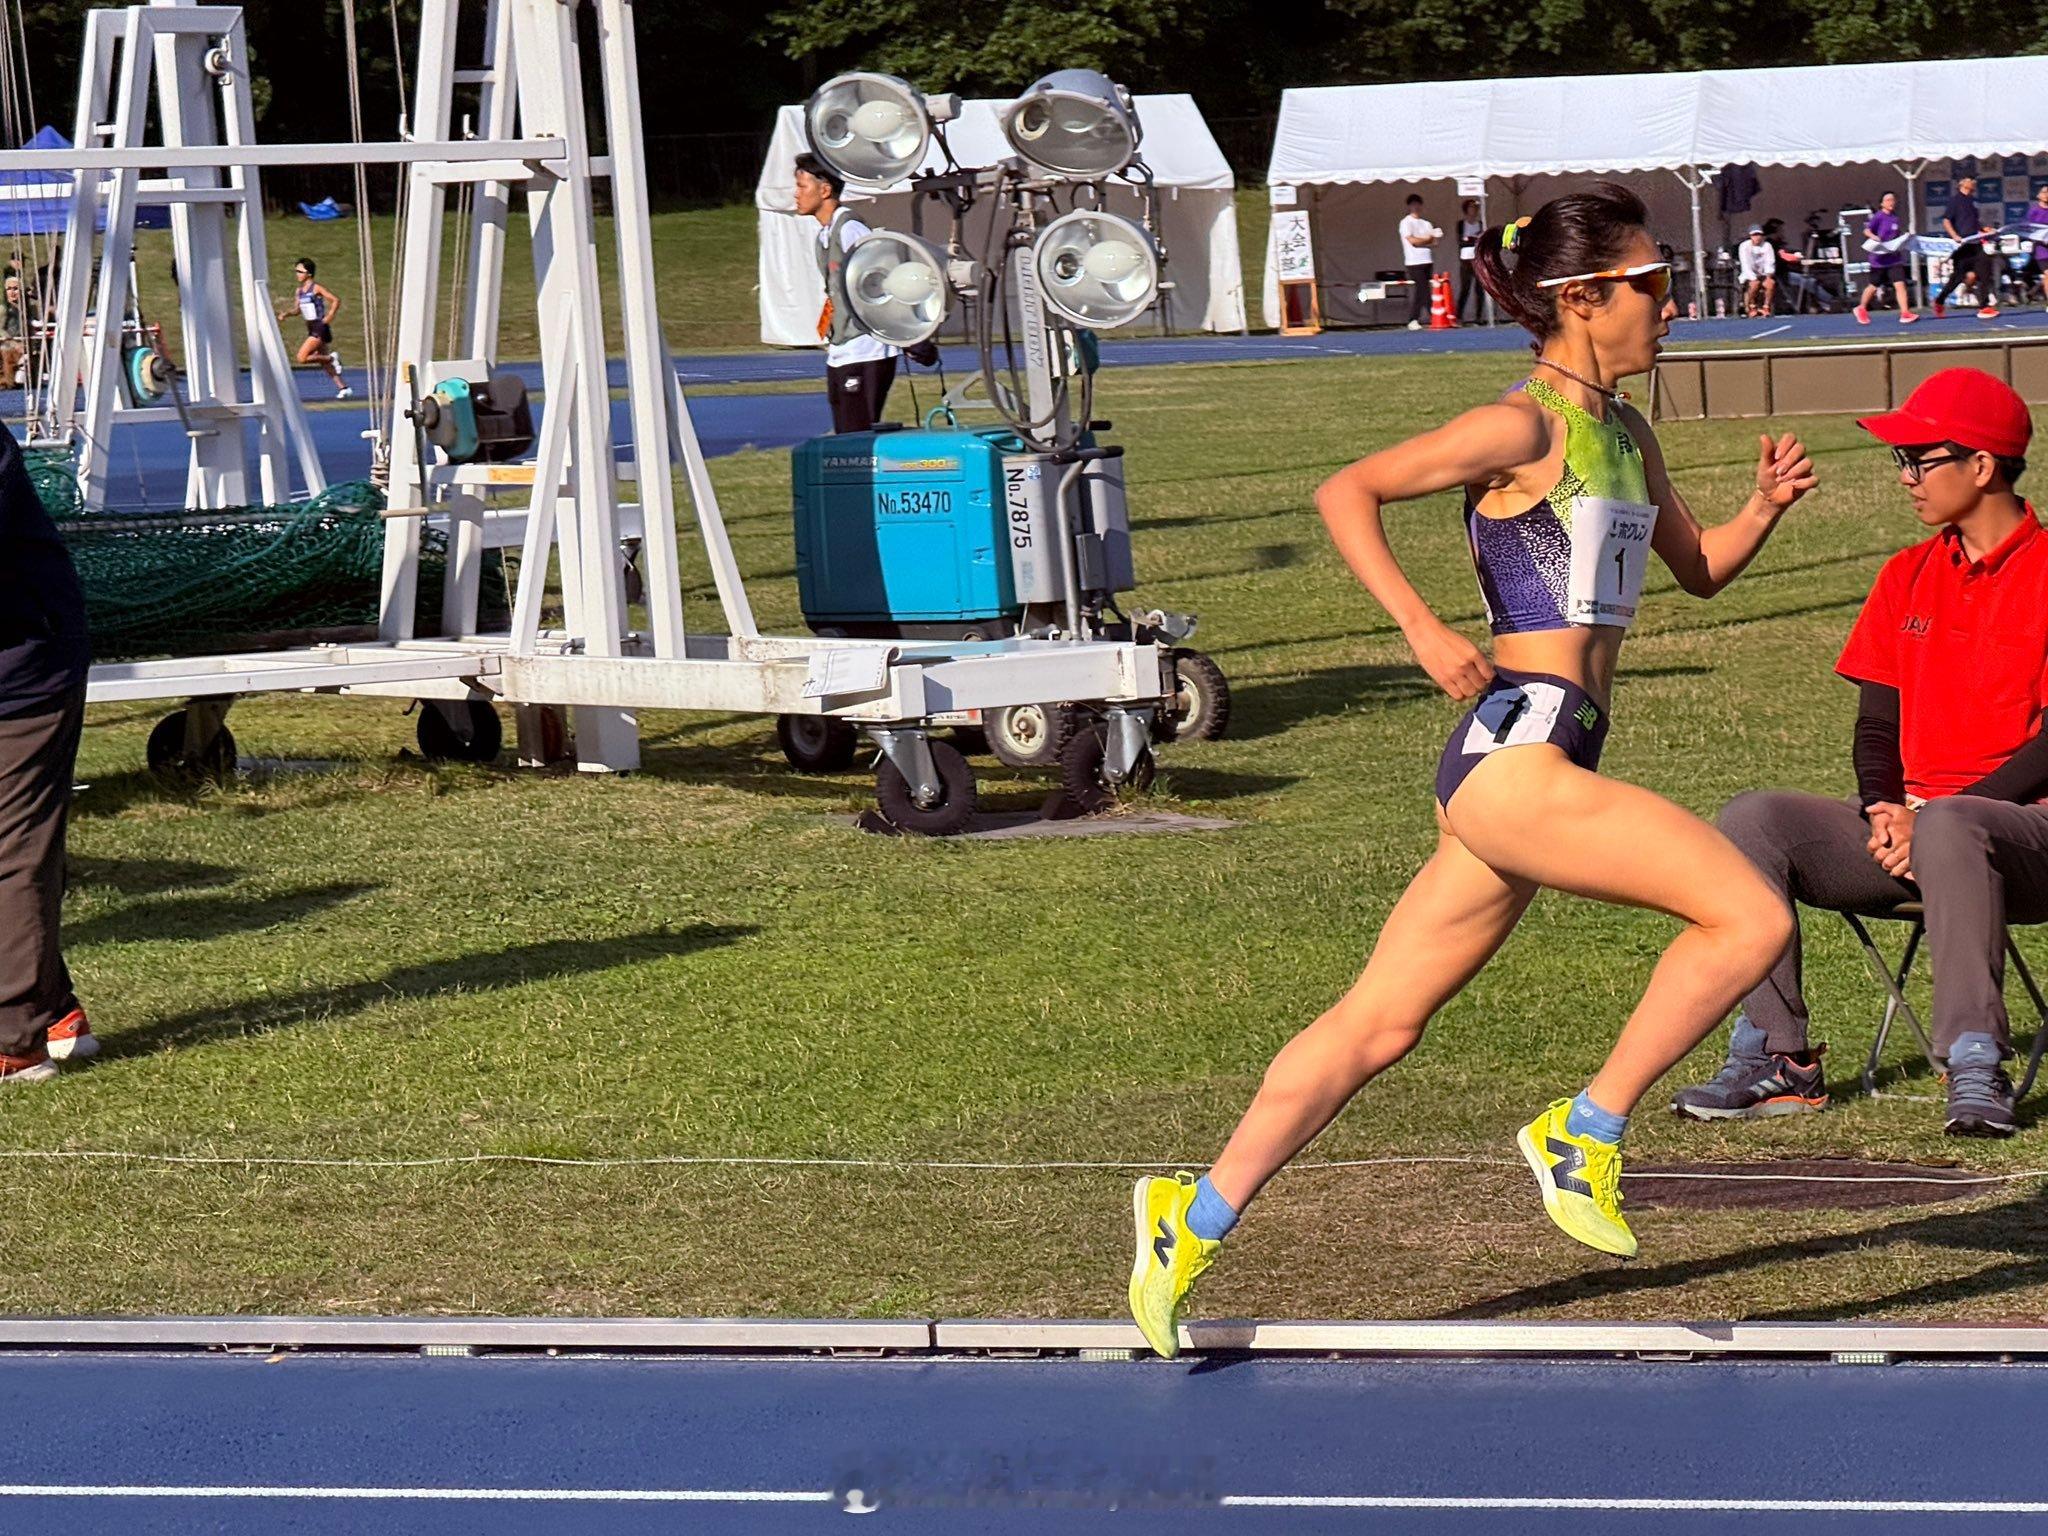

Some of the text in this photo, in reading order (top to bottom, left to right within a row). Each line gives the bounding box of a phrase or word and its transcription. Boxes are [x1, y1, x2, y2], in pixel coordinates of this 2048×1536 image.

[1290, 216, 1306, 248] 大会
[878, 491, 951, 514] No.53470
[1006, 468, 1032, 548] No.7875
[1615, 548, 1625, 595] 1
